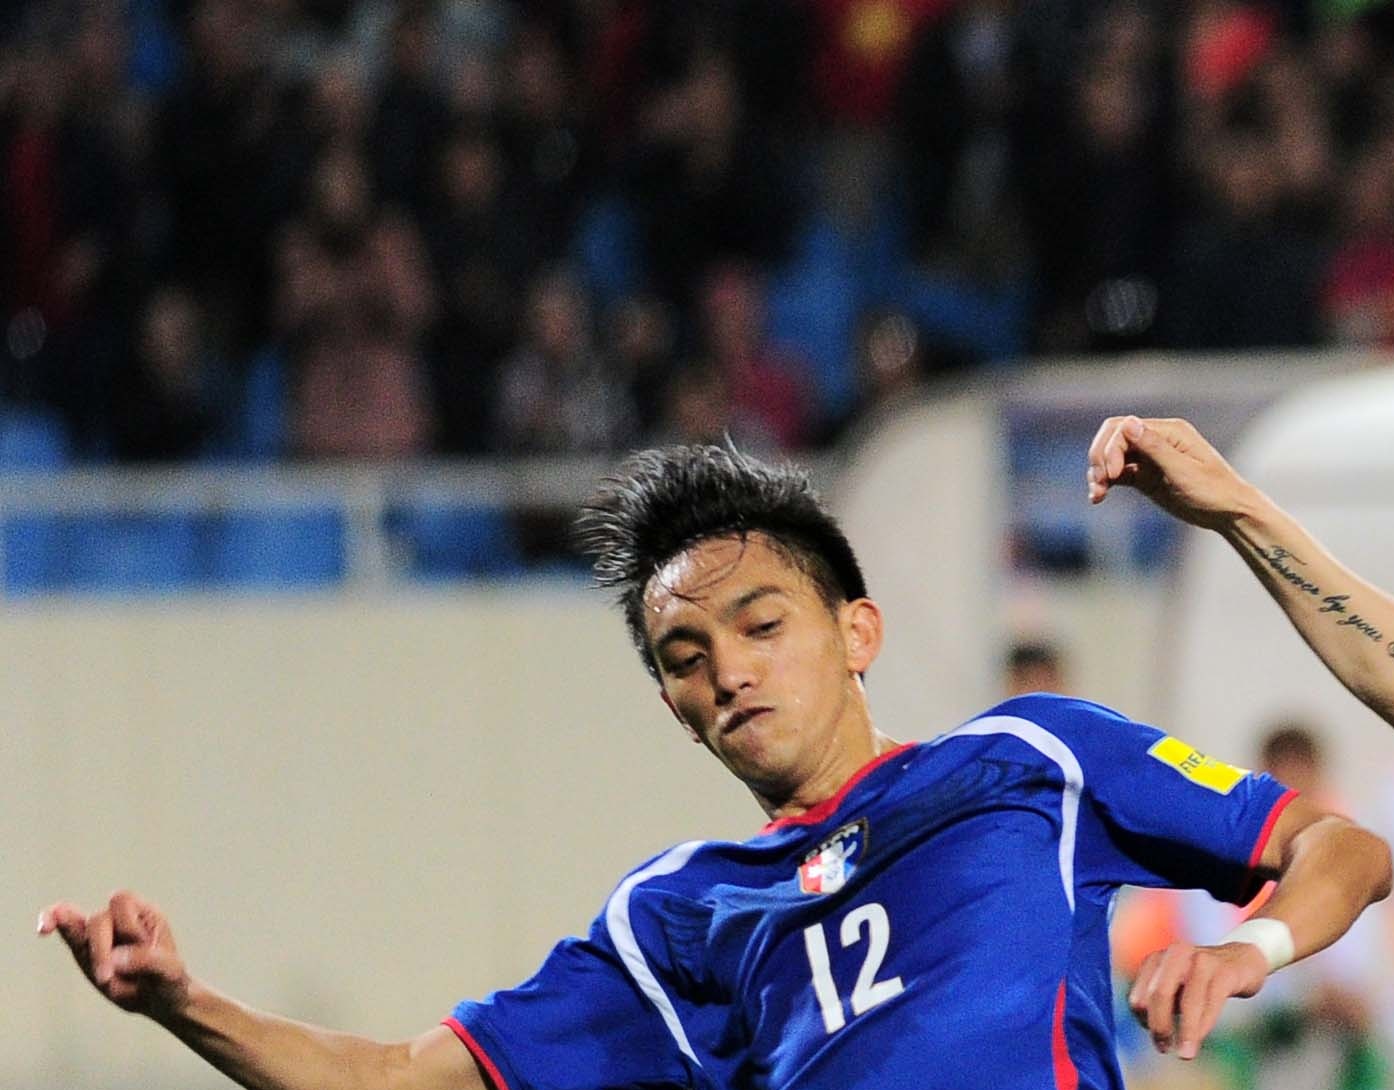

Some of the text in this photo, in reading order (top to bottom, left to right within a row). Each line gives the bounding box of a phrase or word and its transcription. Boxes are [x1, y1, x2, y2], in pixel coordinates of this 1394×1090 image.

[1318, 594, 1350, 613] by
[1336, 614, 1382, 642] your
[803, 902, 905, 1035] 12
